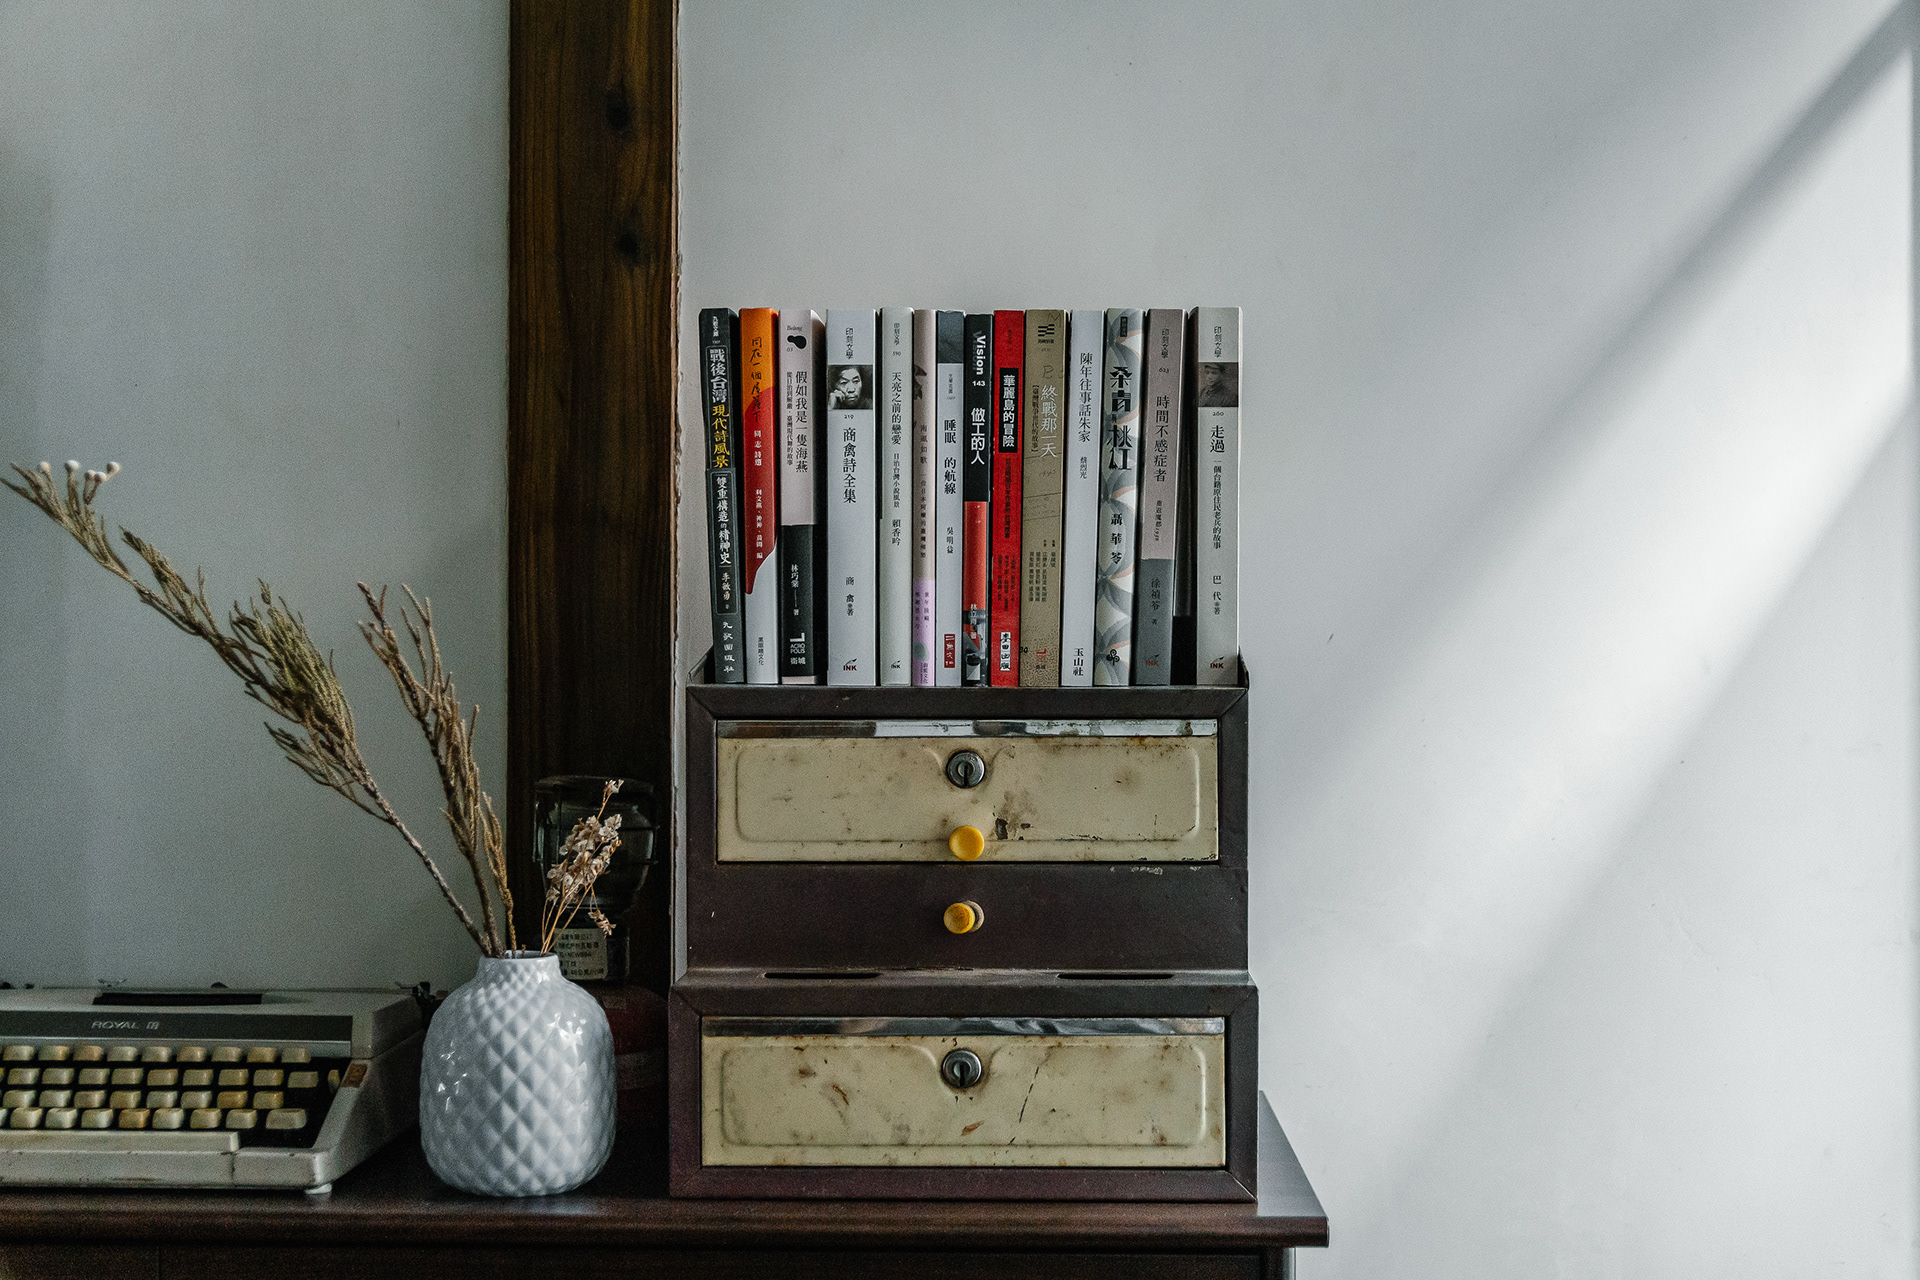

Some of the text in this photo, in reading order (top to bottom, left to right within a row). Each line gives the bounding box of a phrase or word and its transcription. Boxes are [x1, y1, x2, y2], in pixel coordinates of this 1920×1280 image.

[846, 327, 854, 360] 印刻文學
[976, 335, 986, 375] Vision
[1161, 328, 1170, 359] 印刻文學
[1213, 326, 1222, 358] 印刻文學
[710, 349, 730, 469] 戰後台灣現代詩風景
[795, 371, 808, 473] 假如我是一隻海燕
[891, 371, 902, 446] 天亮之前的戀愛
[1003, 375, 1015, 447] 華麗島的冒險
[1040, 384, 1058, 458] 終戰那一天
[1078, 353, 1093, 443] 陳年往事話朱家
[970, 408, 986, 465] 做工的人
[1153, 395, 1170, 482] 時間不感症者
[1210, 425, 1225, 453] 走過
[843, 427, 857, 503] 商禽詩全集
[716, 476, 732, 564] 雙重構造的精神史
[1212, 460, 1222, 549] 一個台籍原住民老兵的故事
[891, 519, 901, 546] 賴香吟
[946, 526, 954, 554] 吳明益
[1110, 513, 1122, 564] 聶華苓
[790, 657, 806, 665] 衛城
[1073, 647, 1084, 676] 玉山社
[91, 1020, 139, 1030] ROYAL
